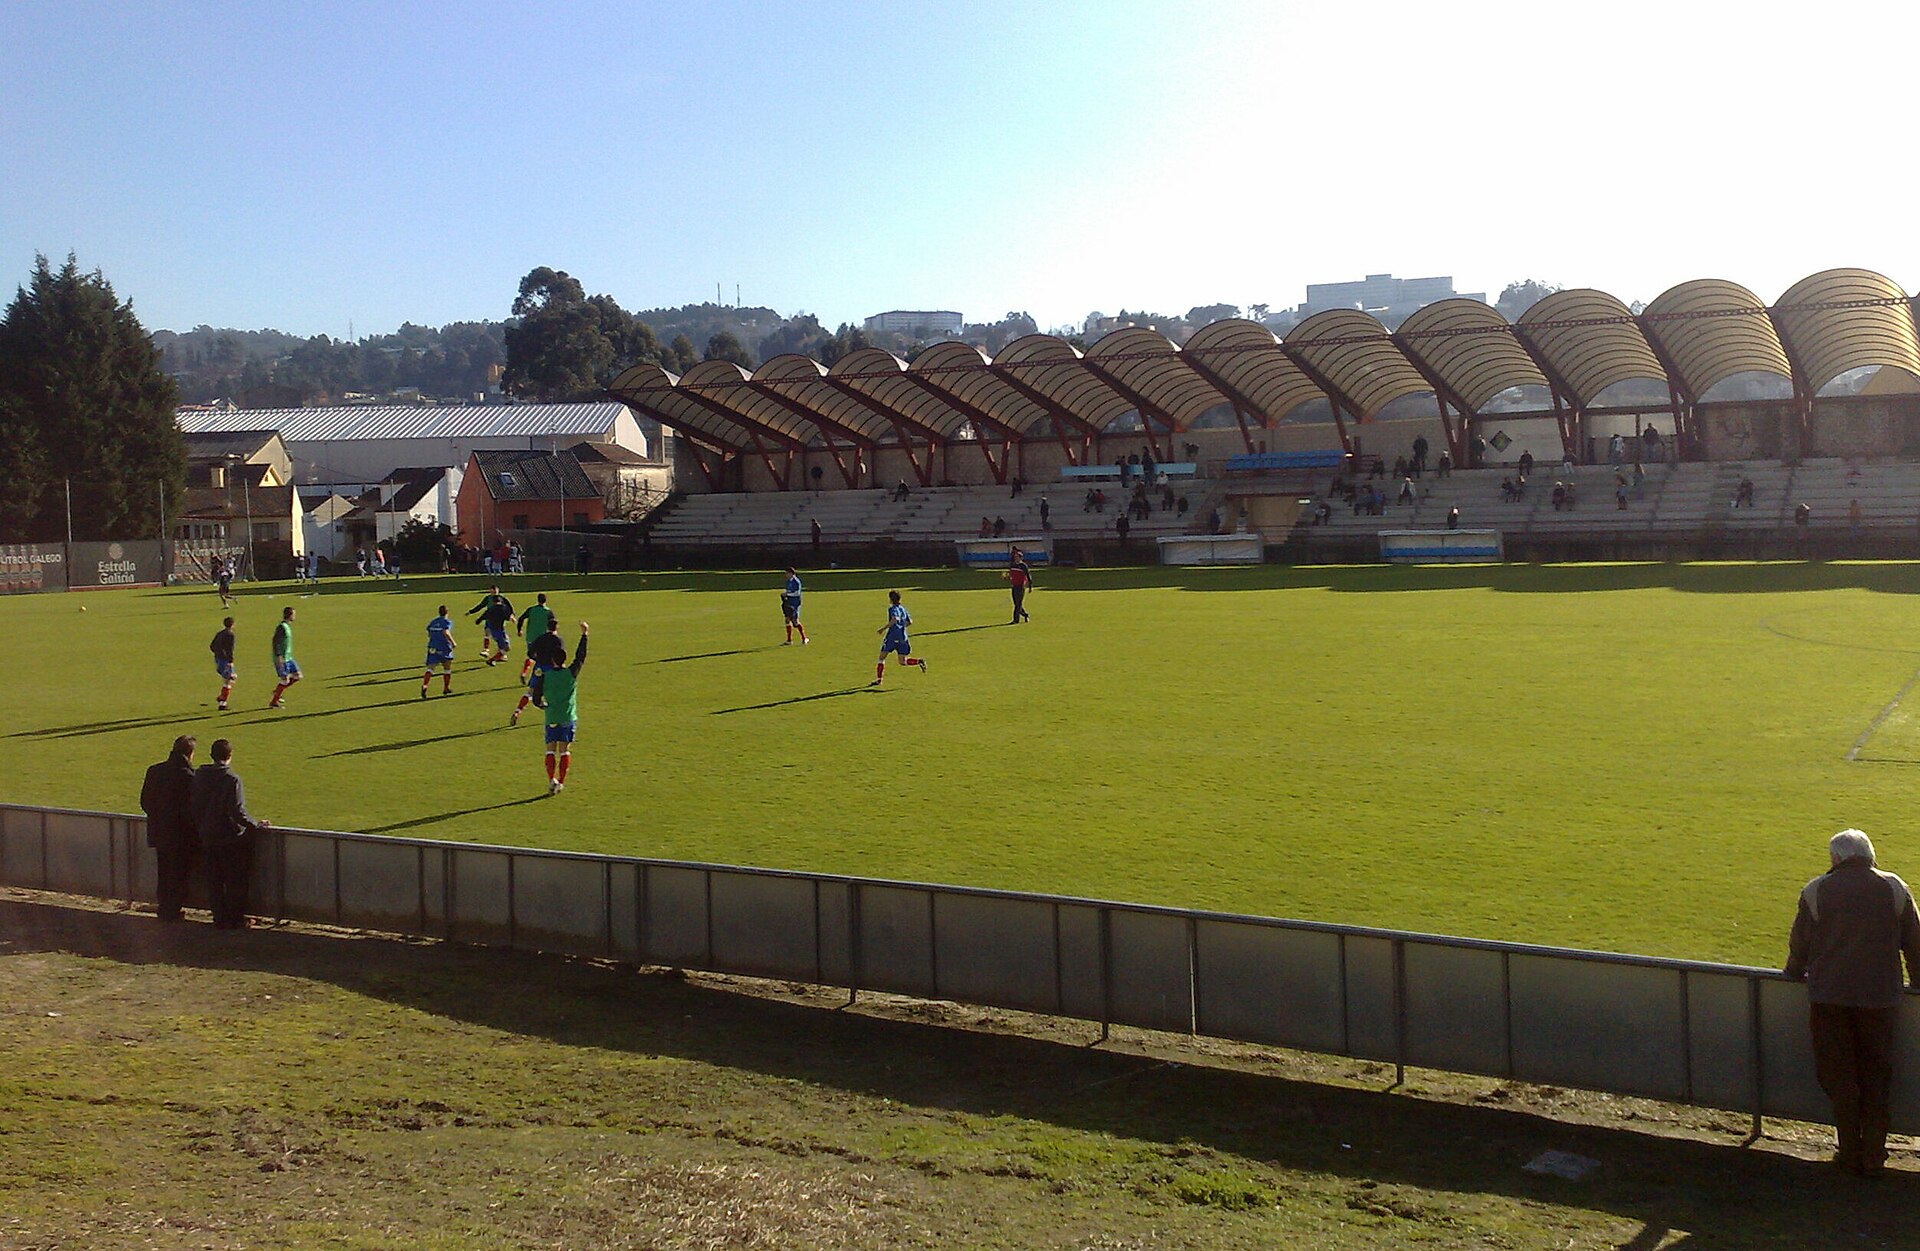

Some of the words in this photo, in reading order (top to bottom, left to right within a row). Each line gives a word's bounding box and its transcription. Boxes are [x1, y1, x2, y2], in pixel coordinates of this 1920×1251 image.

[0, 554, 29, 564] ÚTBOL
[30, 554, 62, 563] GALEGO
[98, 560, 136, 572] Estrella
[99, 572, 135, 584] Galicia
